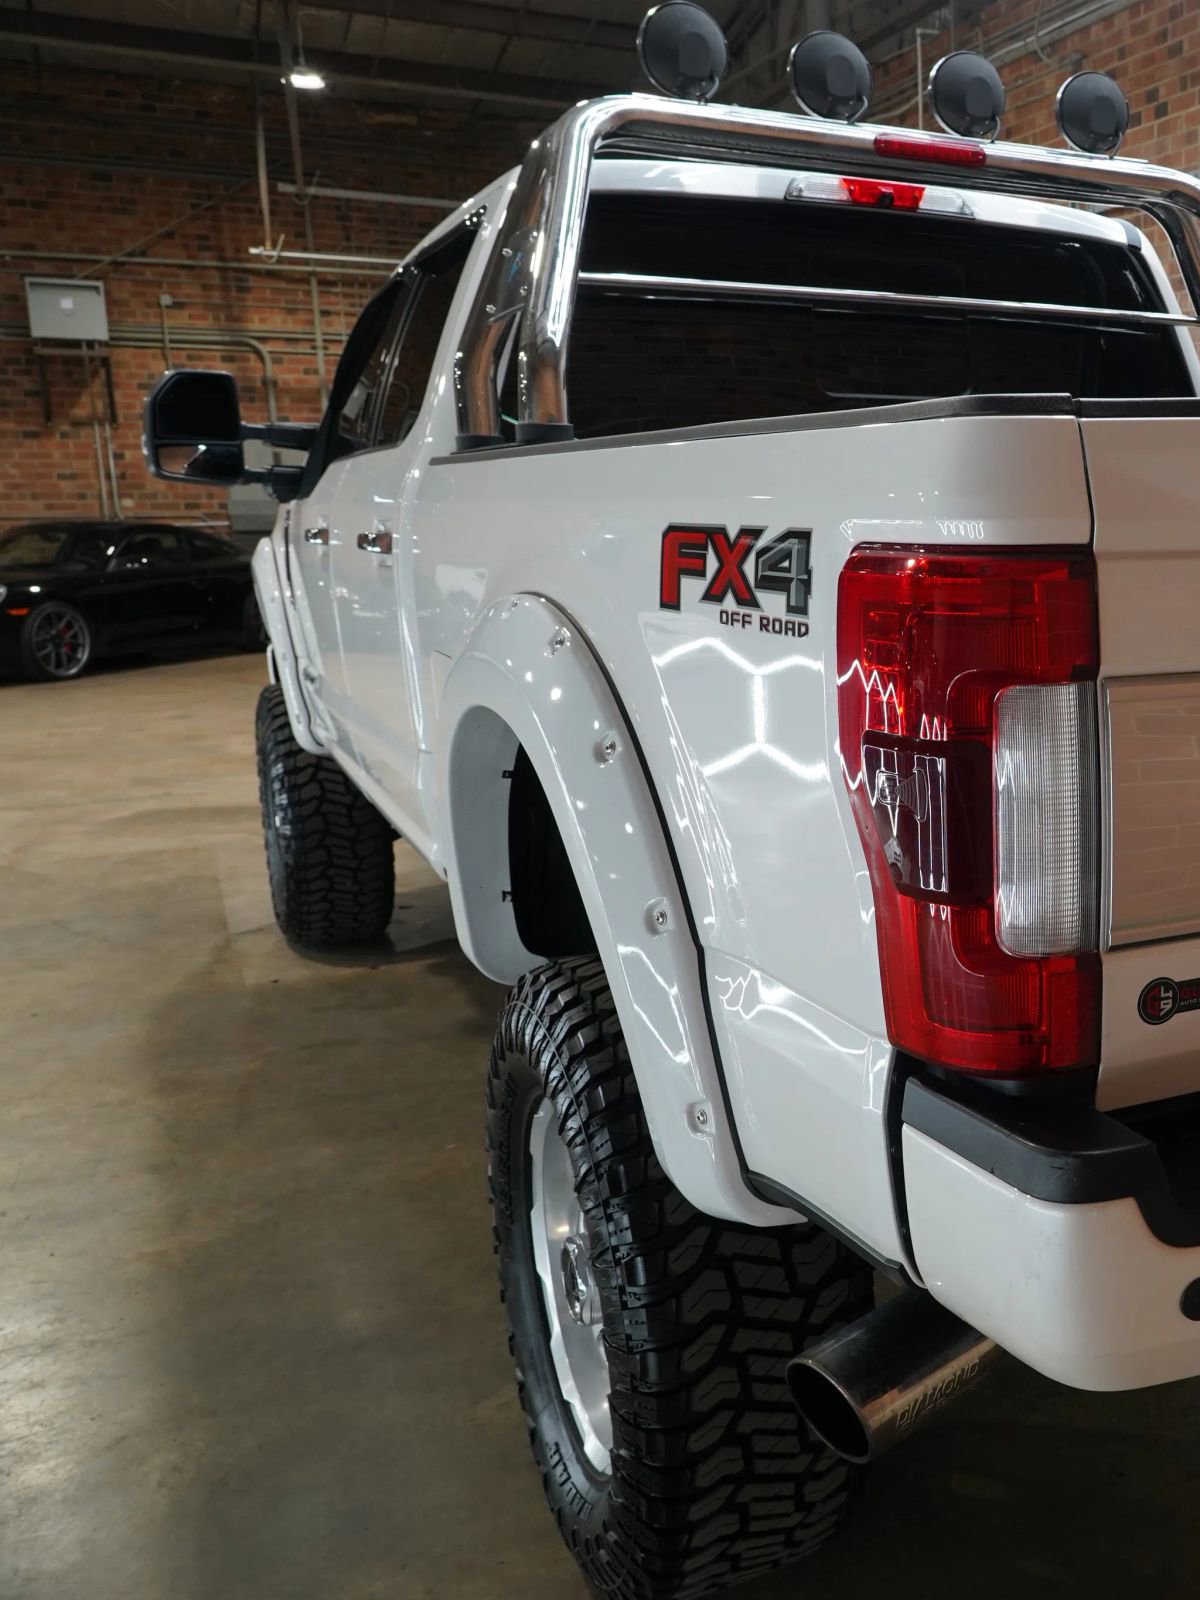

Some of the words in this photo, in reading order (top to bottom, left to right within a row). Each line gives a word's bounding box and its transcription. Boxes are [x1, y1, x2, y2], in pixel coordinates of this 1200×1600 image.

[659, 522, 813, 617] FX4
[719, 609, 752, 629] OFF
[759, 615, 810, 638] ROAD
[1180, 997, 1198, 1006] AUTO
